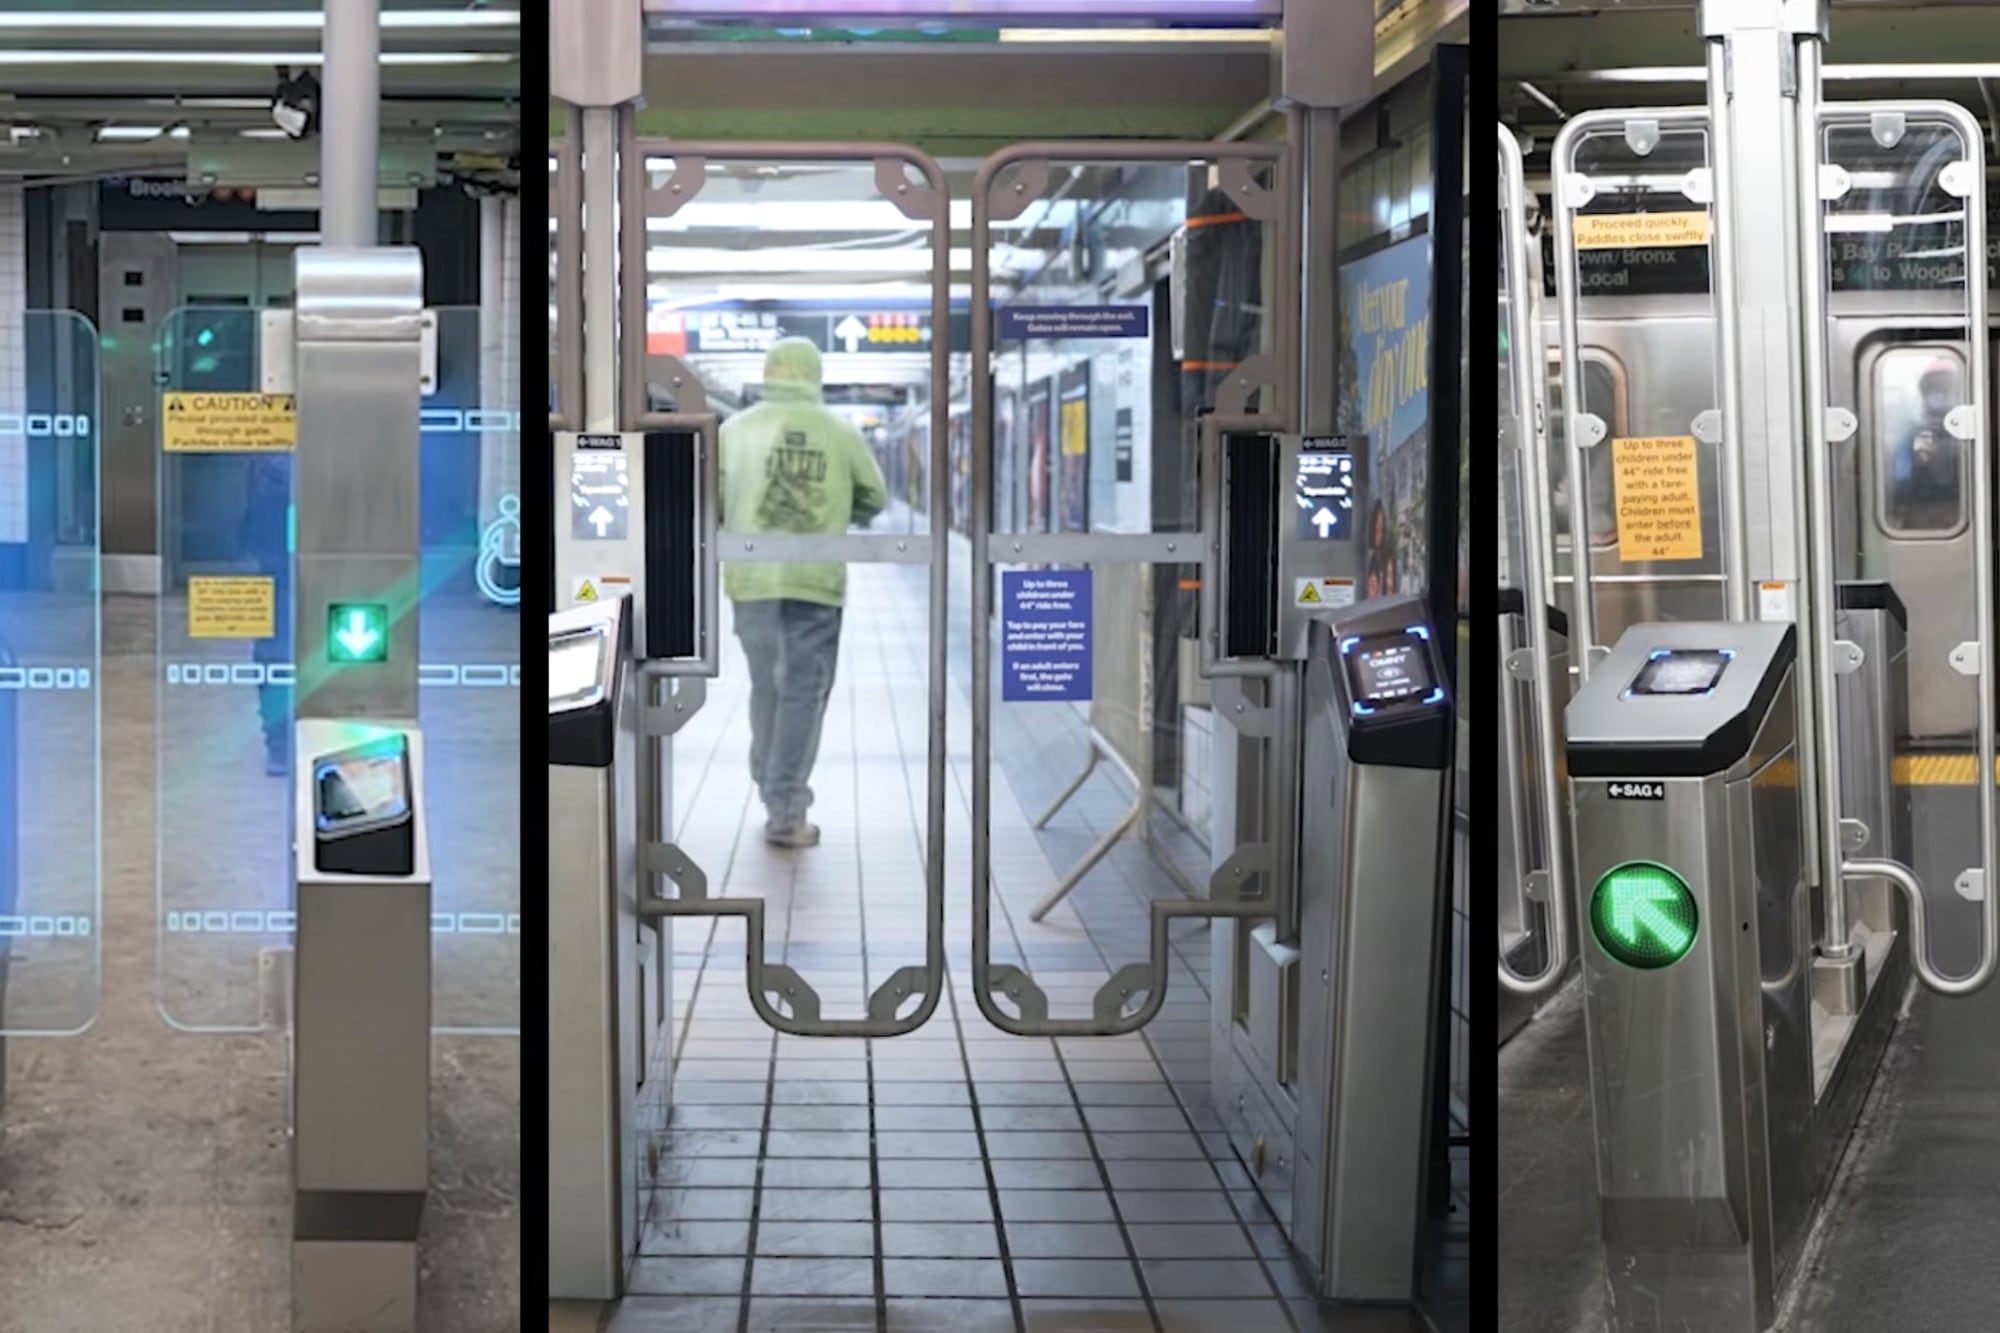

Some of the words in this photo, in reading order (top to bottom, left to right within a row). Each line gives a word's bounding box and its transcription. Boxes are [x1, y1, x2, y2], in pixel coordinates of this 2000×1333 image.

[1591, 218, 1642, 229] Proceed
[1645, 217, 1691, 229] quickly.
[1578, 234, 1625, 245] Paddles
[1629, 231, 1661, 242] close
[1843, 243, 1880, 264] Bay
[1874, 264, 1891, 280] to
[1900, 263, 1996, 281] Woodlan
[1580, 270, 1629, 286] Local
[1037, 312, 1067, 322] moving
[1067, 312, 1101, 323] through
[1102, 312, 1116, 320] the
[193, 396, 273, 410] CAUTION
[1623, 441, 1639, 451] Up
[1642, 440, 1653, 449] to
[1655, 440, 1684, 448] three
[1616, 454, 1659, 463] children
[1662, 452, 1693, 461] under
[1643, 466, 1664, 475] ride
[1667, 466, 1688, 474] free
[1626, 481, 1648, 489] with
[1661, 480, 1686, 488] fare-
[1622, 494, 1658, 504] paying
[1661, 492, 1691, 502] adult.
[1620, 506, 1665, 516] Children
[1667, 505, 1695, 515] must
[1625, 521, 1653, 530] enter
[1657, 519, 1691, 529] before
[1634, 533, 1651, 543] the
[1023, 580, 1035, 590] Up
[1036, 580, 1045, 588] to
[1045, 580, 1068, 589] three
[1007, 620, 1021, 630] Tap
[1022, 621, 1032, 629] to
[1623, 783, 1652, 797] SAG
[1653, 785, 1663, 797] 4
